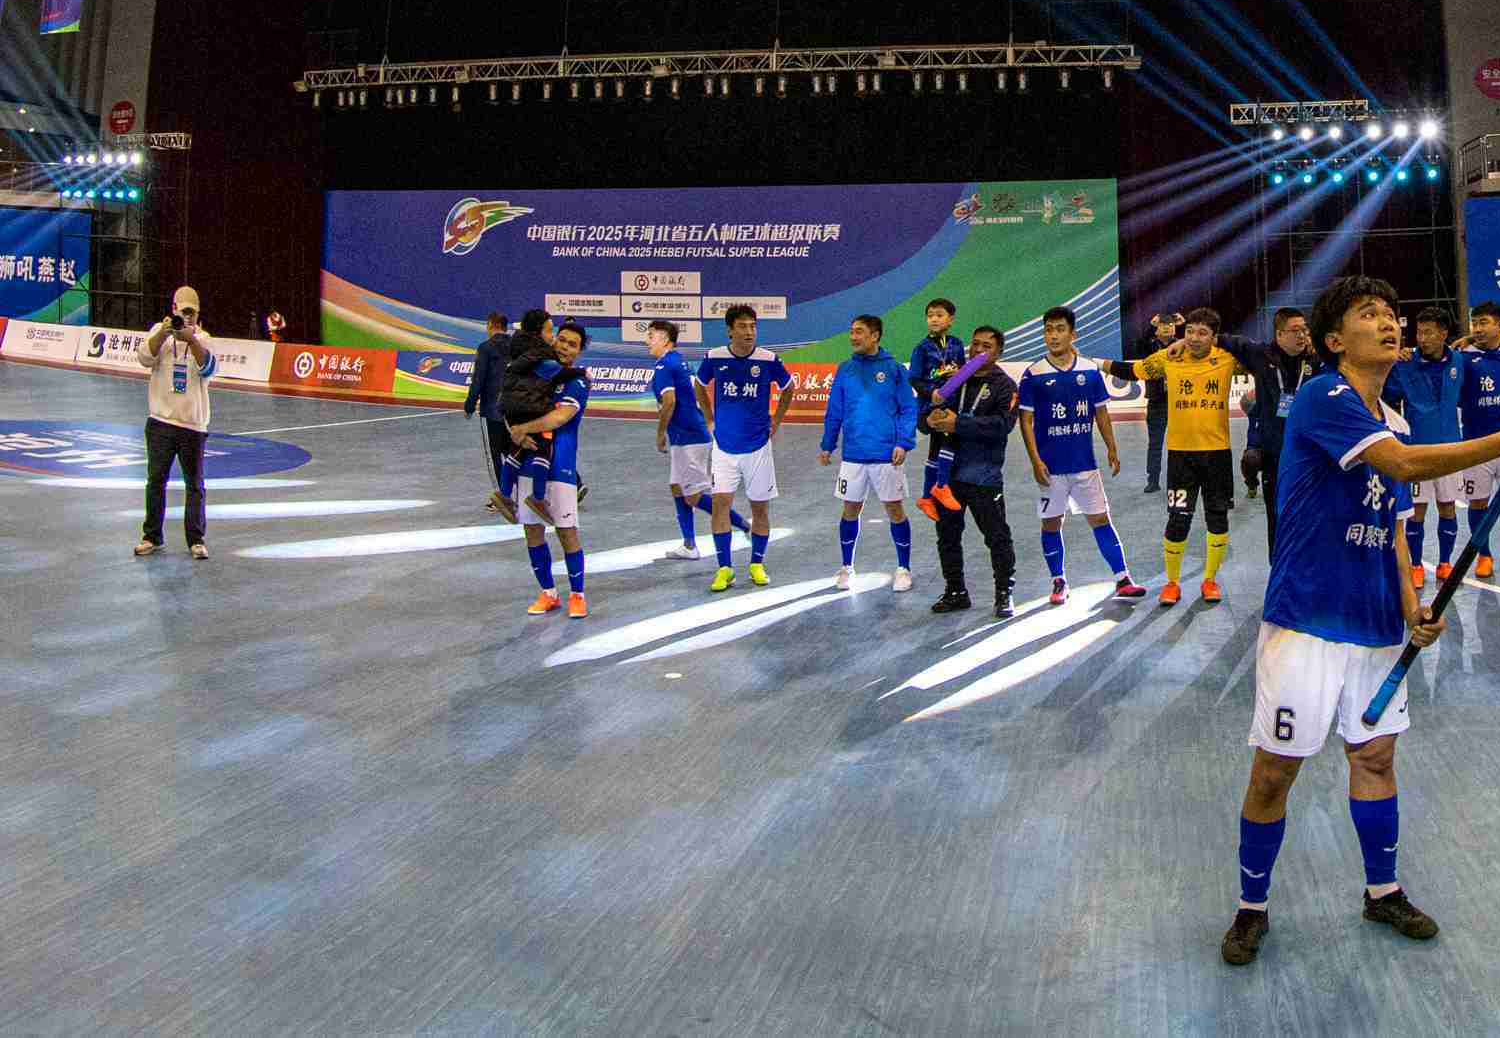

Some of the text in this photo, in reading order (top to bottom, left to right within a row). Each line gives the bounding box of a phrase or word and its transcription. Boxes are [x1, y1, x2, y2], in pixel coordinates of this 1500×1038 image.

[527, 223, 841, 244] 中国银行2025年河北省五人制足球超级联赛
[552, 246, 810, 258] BANK OF CHINA 2025 HEBEI FUTSAL SUPER LEAGUE
[318, 354, 366, 373] 中国银行
[615, 384, 648, 393] LEAGUE
[722, 381, 758, 397] 沧州
[1179, 378, 1219, 395] 沧州
[1051, 399, 1089, 418] 沧州
[1275, 707, 1295, 741] 6
